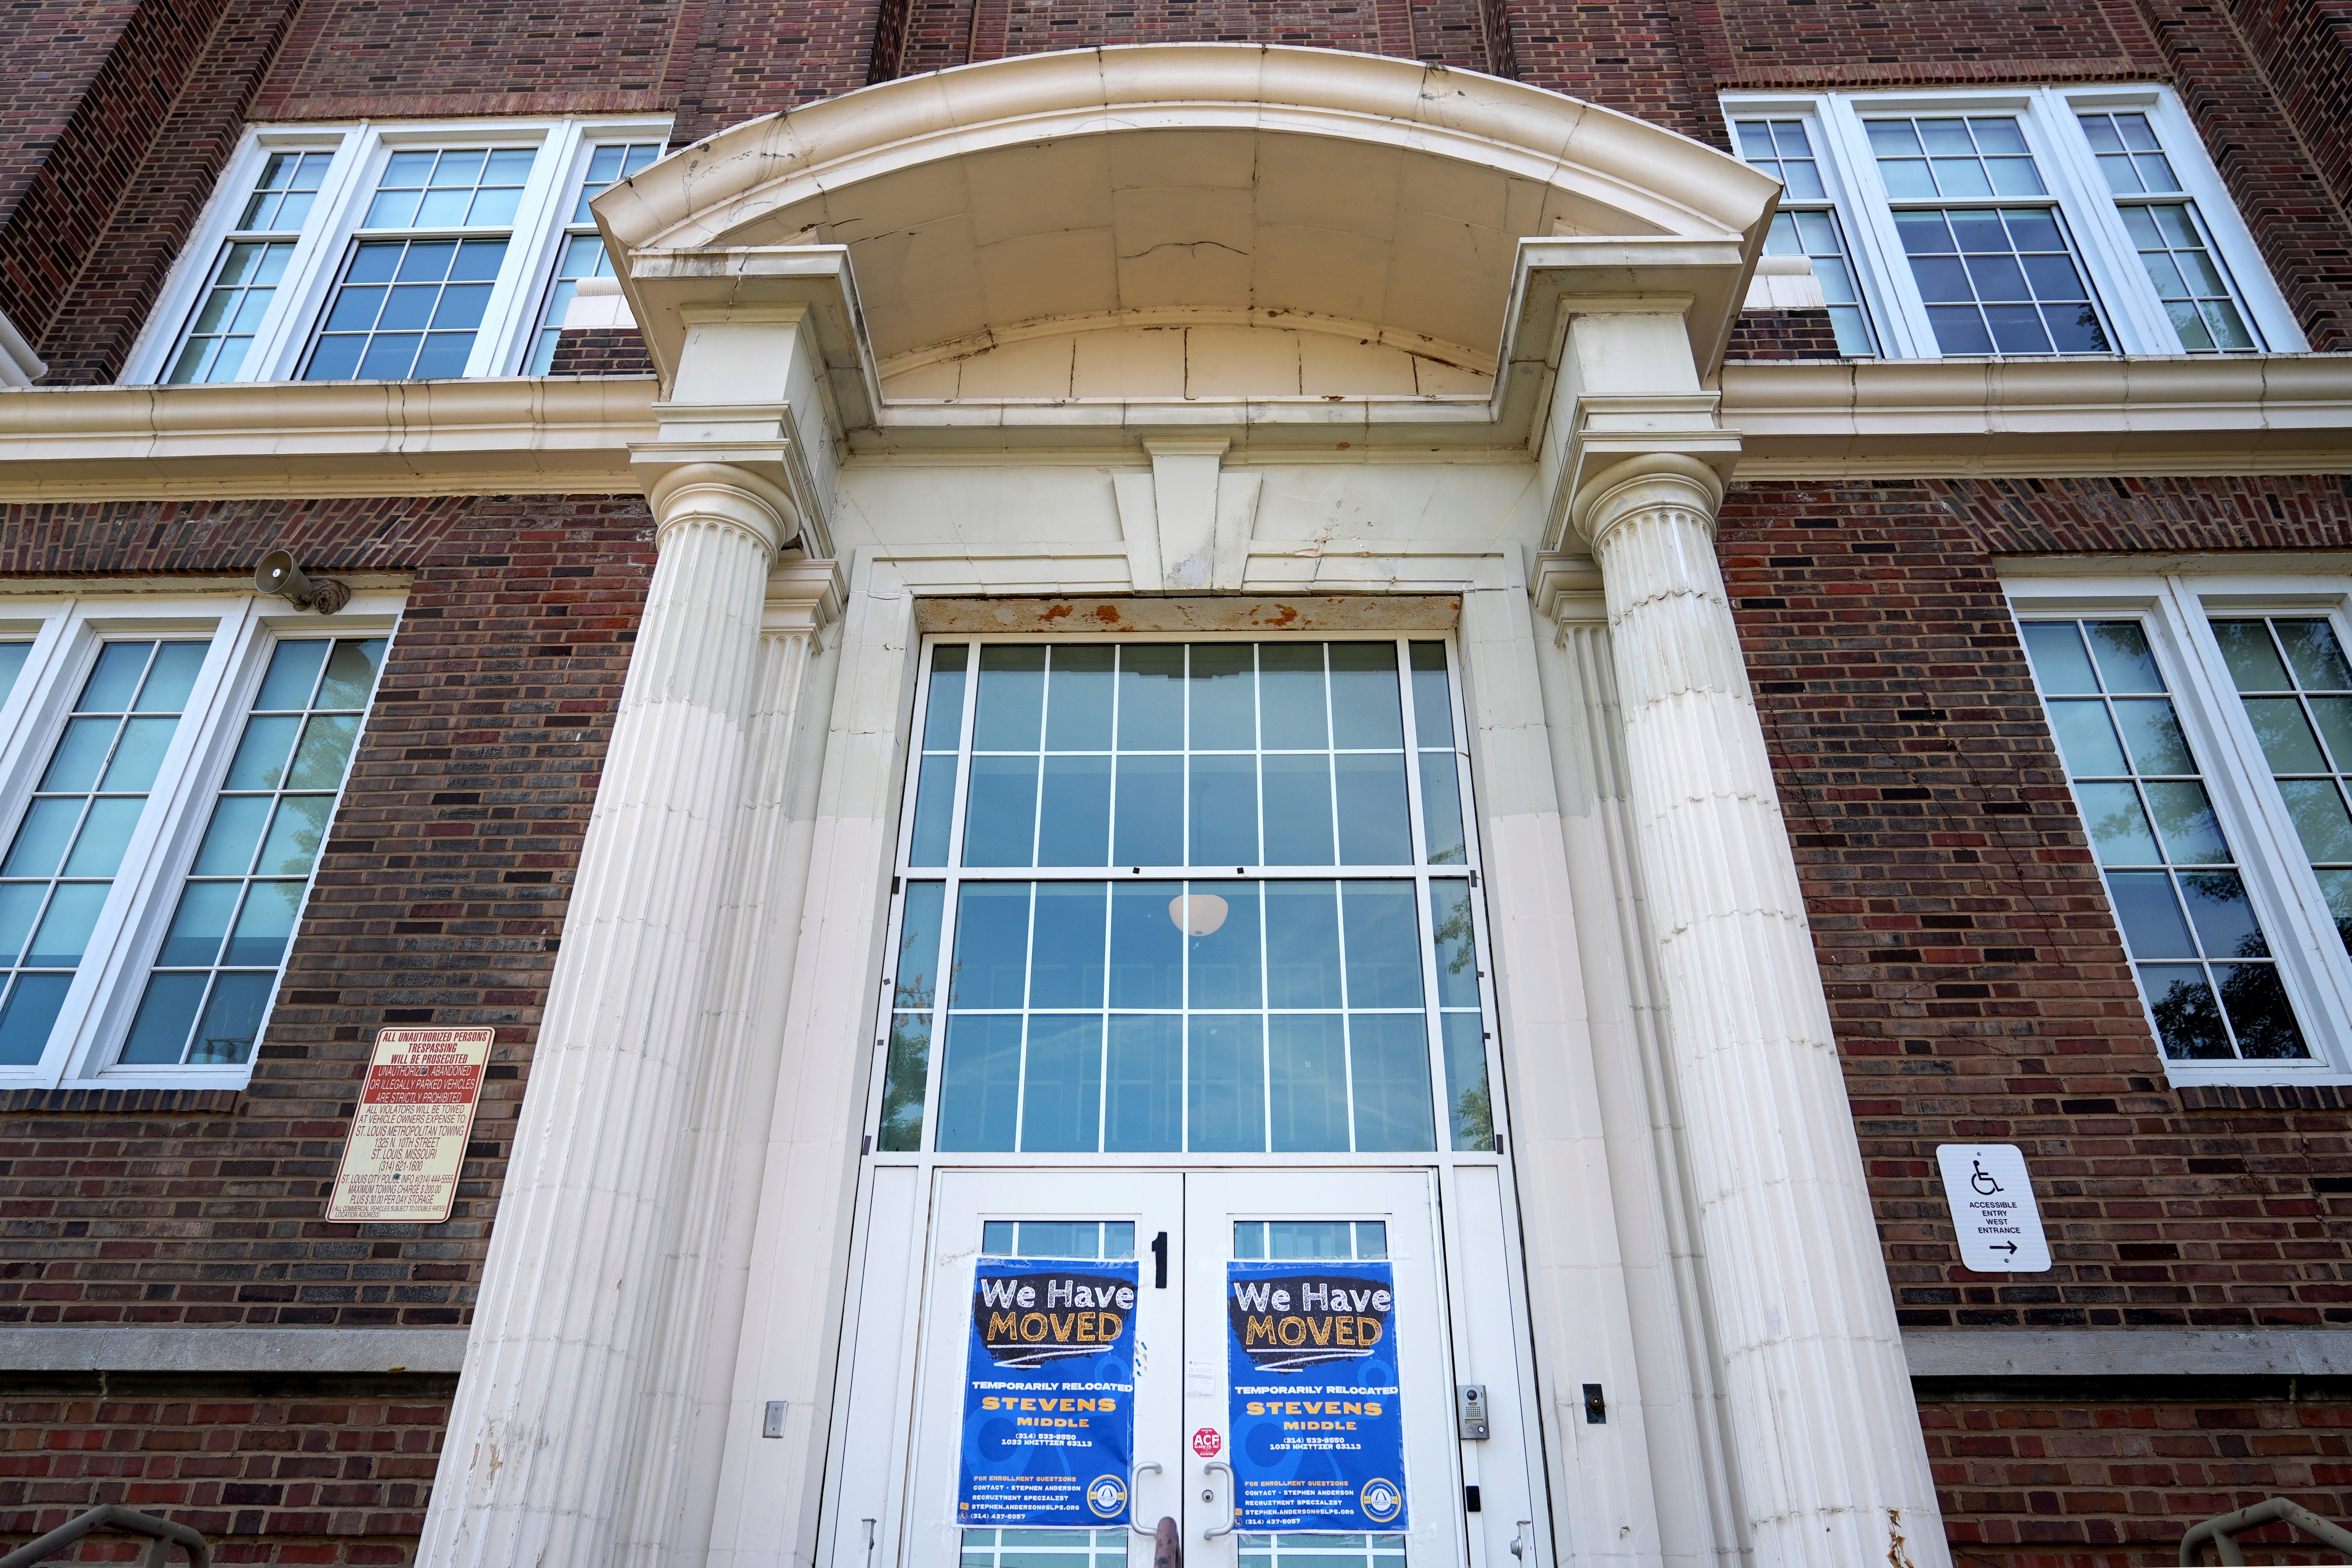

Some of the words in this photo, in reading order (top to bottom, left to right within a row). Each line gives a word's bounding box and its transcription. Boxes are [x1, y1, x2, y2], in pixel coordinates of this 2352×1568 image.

[383, 1032, 395, 1042] ALL
[398, 1032, 453, 1042] UNAUTHORIZED
[454, 1032, 487, 1042] PERSONS
[408, 1043, 457, 1053] TRESPASSING
[391, 1054, 407, 1064] WILL
[410, 1054, 421, 1064] BE
[421, 1054, 468, 1064] PROSECUTED
[378, 1066, 429, 1078] UNAUTHORIZED,
[431, 1066, 472, 1076] ABANDONED
[370, 1079, 380, 1089] OR
[380, 1079, 415, 1089] ILLEGALLY
[415, 1079, 443, 1089] PARKED
[444, 1079, 475, 1089] VEHICLES
[375, 1093, 391, 1103] ARE
[391, 1093, 421, 1103] STRICTLY
[421, 1092, 462, 1103] PROHIBITED
[366, 1105, 377, 1113] ALL
[379, 1105, 415, 1113] VIOLATORS
[416, 1105, 430, 1113] WILL
[431, 1105, 441, 1113] BE
[442, 1105, 464, 1113] TOWED
[358, 1115, 368, 1123] AT
[369, 1115, 396, 1123] VEHICLE
[397, 1115, 425, 1123] OWNERS
[426, 1115, 455, 1123] EXPENSE
[457, 1115, 467, 1123] TO:
[356, 1126, 366, 1136] ST.
[367, 1126, 387, 1136] LOUIS
[387, 1126, 438, 1136] METROPOLITAN
[438, 1126, 464, 1136] TOWING
[375, 1137, 389, 1147] 1325
[389, 1137, 396, 1147] N.
[398, 1137, 414, 1147] 10TH
[414, 1137, 441, 1147] STREET
[371, 1149, 381, 1159] ST.
[382, 1149, 403, 1161] LOUIS,
[405, 1149, 437, 1159] MISSOURI
[379, 1161, 395, 1174] (314)
[395, 1161, 423, 1171] 621-1600
[341, 1175, 350, 1184] ST.
[351, 1175, 368, 1183] LOUIS
[368, 1175, 381, 1183] CITY
[381, 1175, 401, 1184] POLICE
[401, 1175, 415, 1183] INFO
[431, 1175, 454, 1183] 444-5555
[348, 1185, 375, 1194] MAXIMUM
[376, 1185, 396, 1194] TOWING
[397, 1185, 421, 1194] CHARGE
[350, 1195, 365, 1204] PLUS
[383, 1195, 396, 1204] PER
[395, 1195, 407, 1204] DAY
[407, 1195, 434, 1204] STORAGE
[1152, 1232, 1167, 1288] 1
[981, 1279, 1036, 1309] We
[1048, 1279, 1134, 1309] Have
[1233, 1282, 1291, 1312] We
[1302, 1283, 1391, 1312] Have
[987, 1312, 1123, 1342] MOVED
[1246, 1315, 1383, 1346] MOVED
[972, 1382, 1059, 1390] TEMPORARILY
[1062, 1383, 1133, 1392] RELOCATED
[1235, 1386, 1323, 1394] TEMPORARILY
[1326, 1386, 1398, 1395] RELOCATED
[982, 1397, 1116, 1412] STEVENS
[1246, 1402, 1383, 1416] STEVENS
[1017, 1418, 1089, 1427] MIDDLE
[1284, 1422, 1357, 1430] MIDDLE
[1194, 1435, 1219, 1445] ACF
